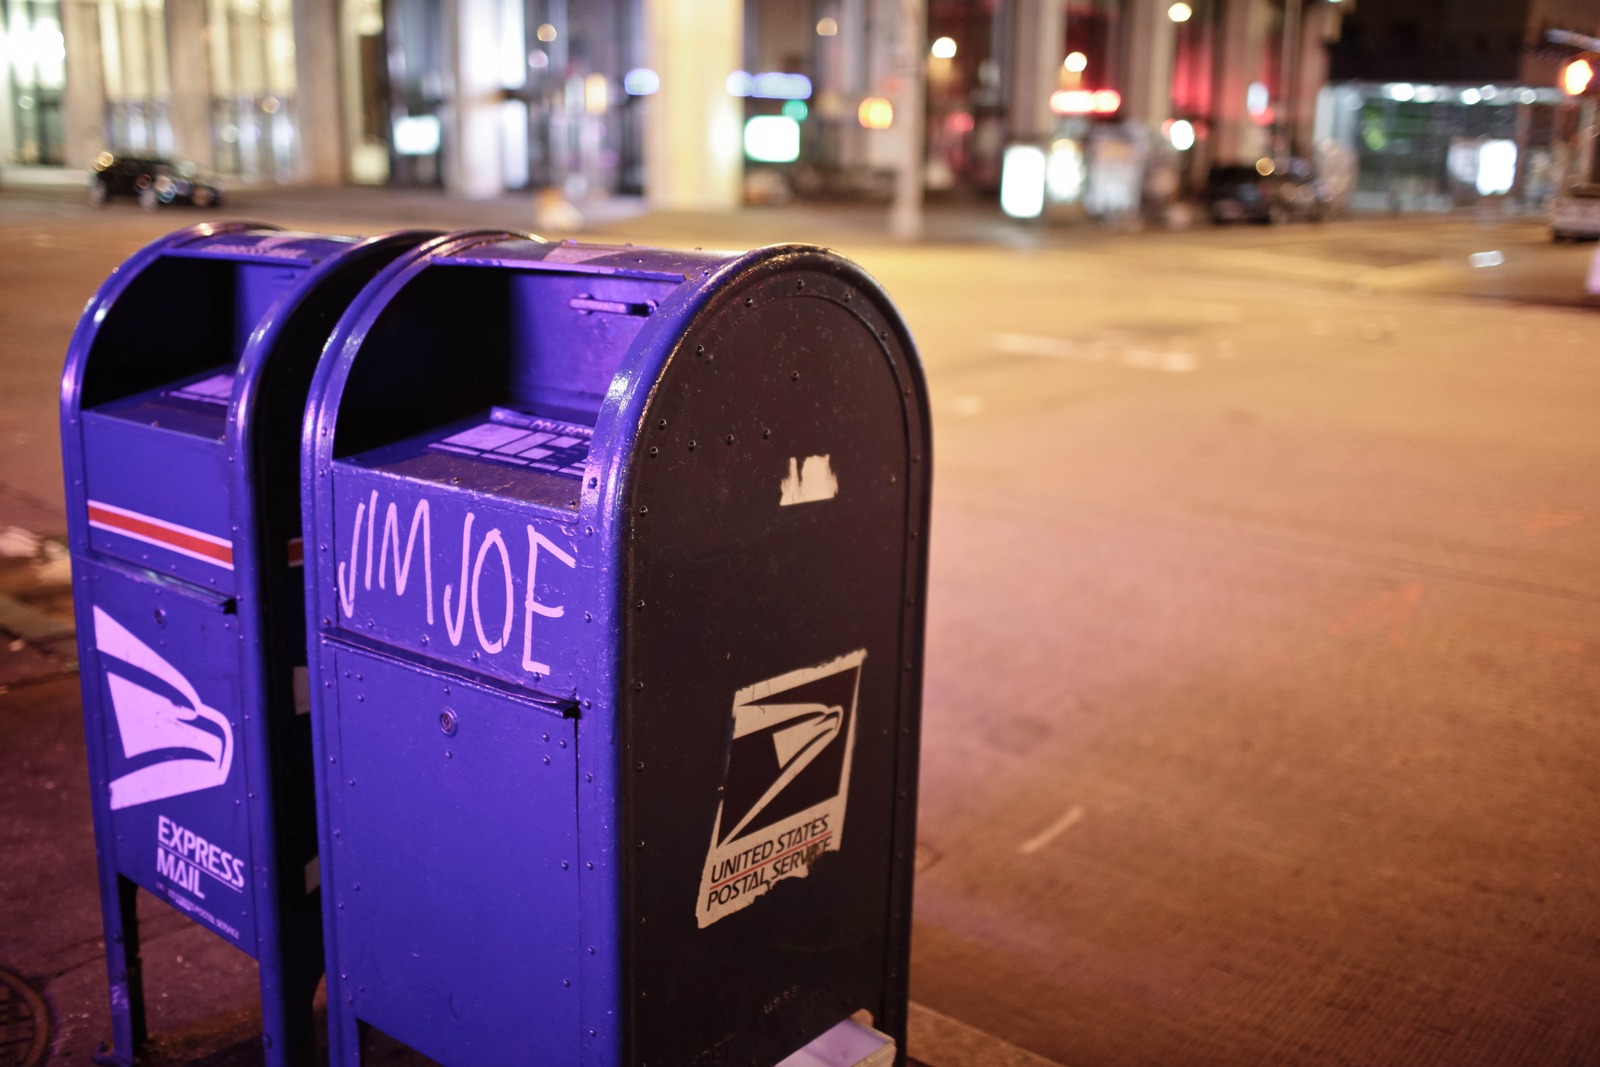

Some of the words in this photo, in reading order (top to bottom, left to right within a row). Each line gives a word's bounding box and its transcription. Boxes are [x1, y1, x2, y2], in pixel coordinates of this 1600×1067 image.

[338, 489, 434, 625] JIM
[443, 512, 577, 676] JOE
[156, 846, 206, 900] MAIL
[157, 815, 245, 888] EXPRESS
[706, 868, 770, 912] POSTAL
[771, 835, 833, 880] SERVICE
[710, 840, 775, 884] UNITED
[775, 813, 830, 854] STATES
